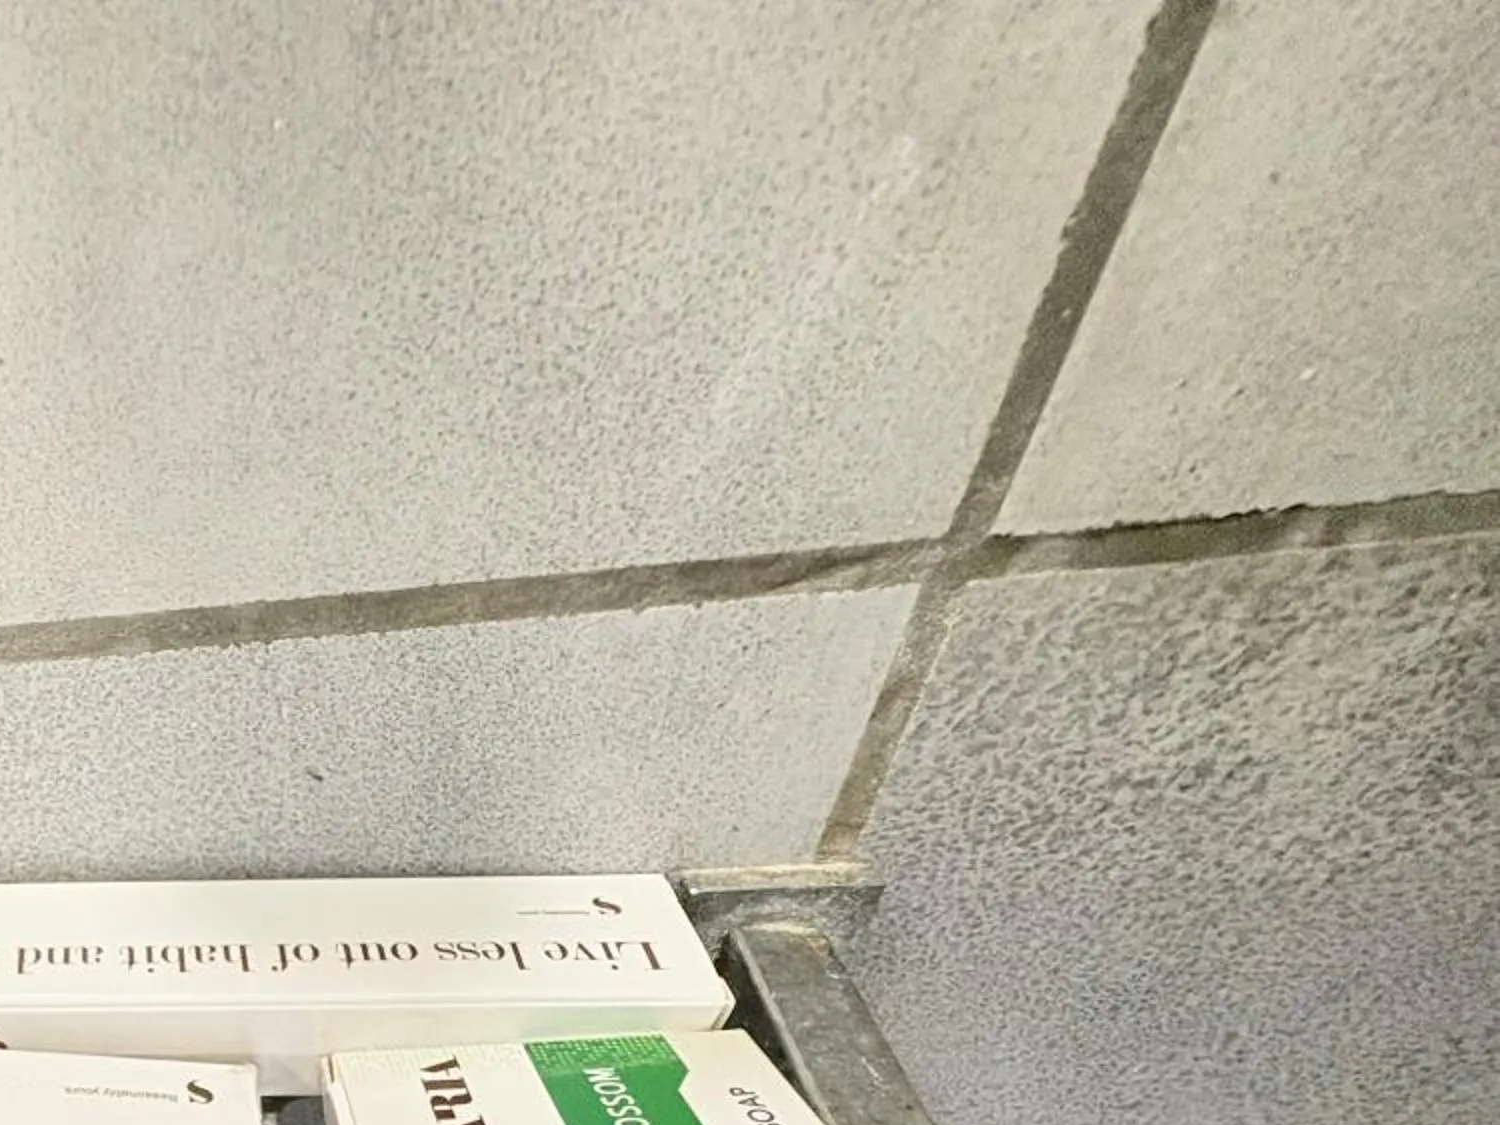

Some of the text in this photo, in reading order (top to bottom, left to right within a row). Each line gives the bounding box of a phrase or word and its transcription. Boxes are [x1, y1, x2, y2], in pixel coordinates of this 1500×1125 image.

[16, 946, 104, 974] and
[118, 944, 253, 973] habit
[269, 942, 320, 973] of
[334, 942, 418, 970] out
[433, 941, 530, 971] less
[543, 940, 664, 971] Live
